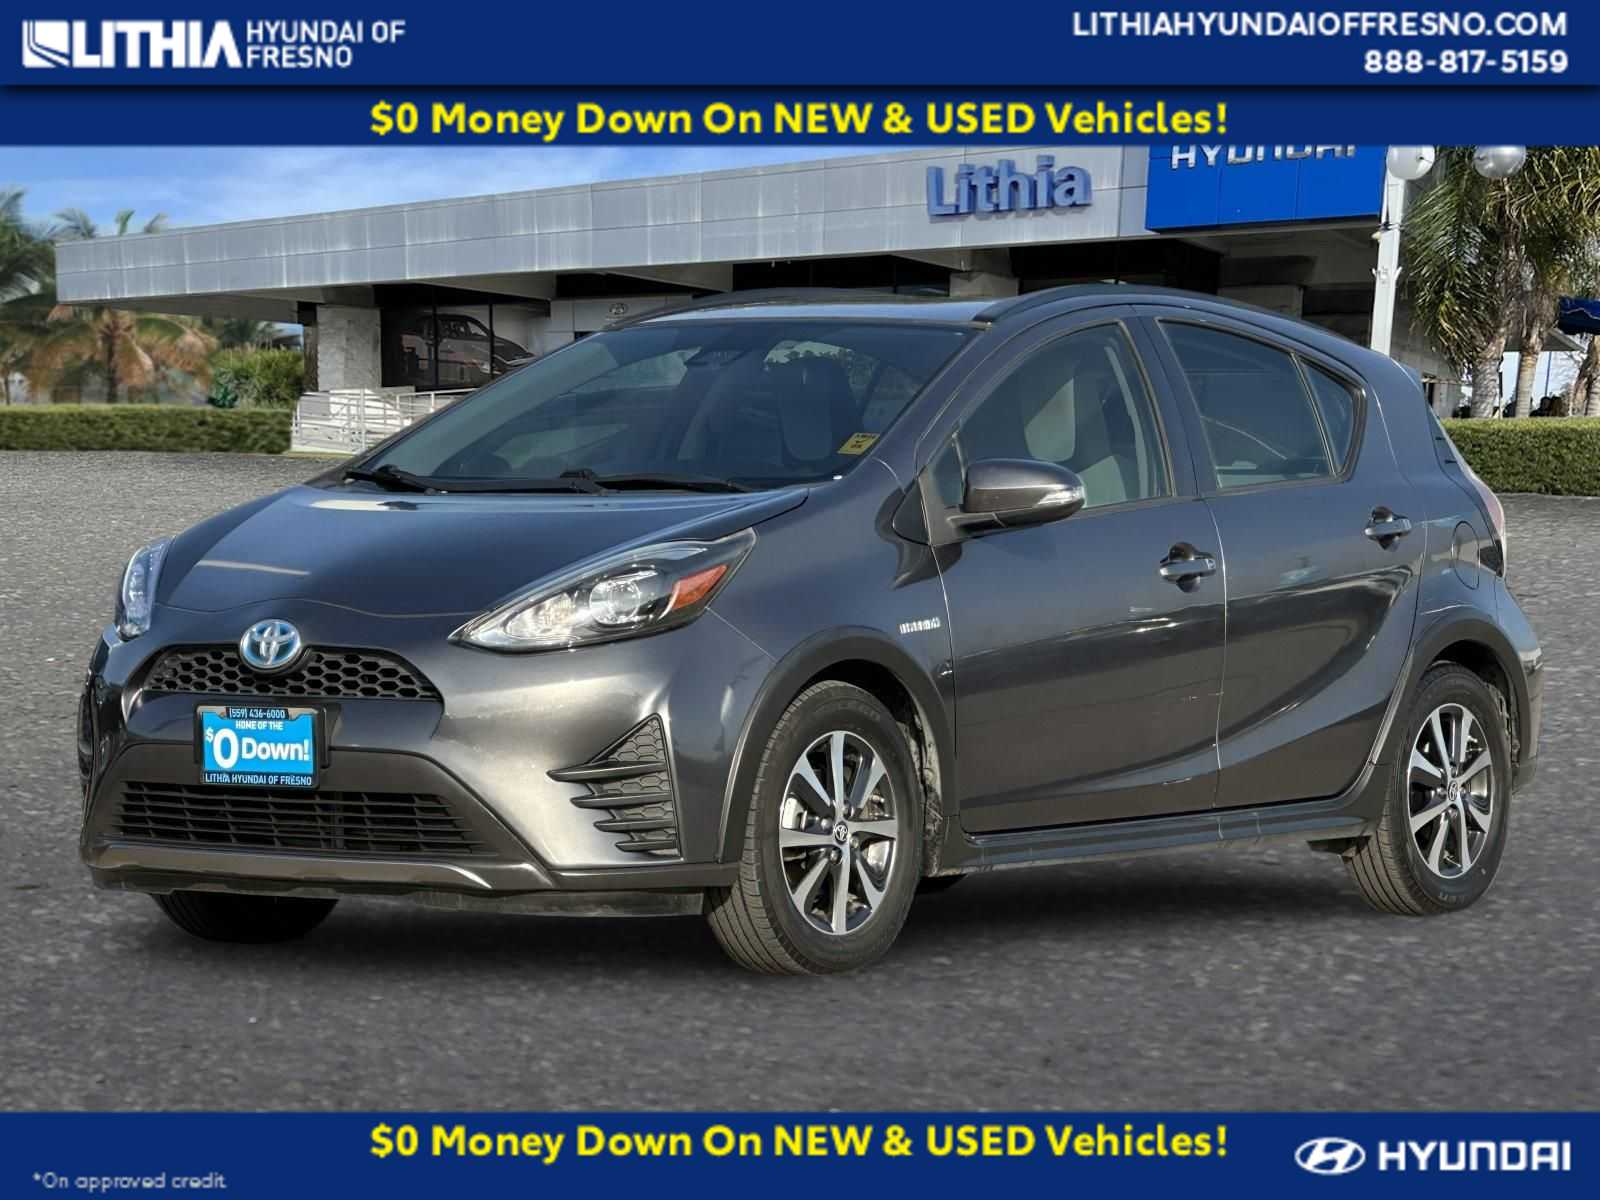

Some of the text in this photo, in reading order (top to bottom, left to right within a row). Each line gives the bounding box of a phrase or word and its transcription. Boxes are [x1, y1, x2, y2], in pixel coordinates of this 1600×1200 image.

[926, 154, 1092, 216] Lithia
[229, 707, 285, 718] (559) 436-6000
[235, 720, 284, 731] HOME OF THE
[241, 738, 310, 760] Down!
[231, 774, 267, 785] HYUNDAI
[268, 775, 279, 785] OF
[280, 775, 312, 786] FRESNO
